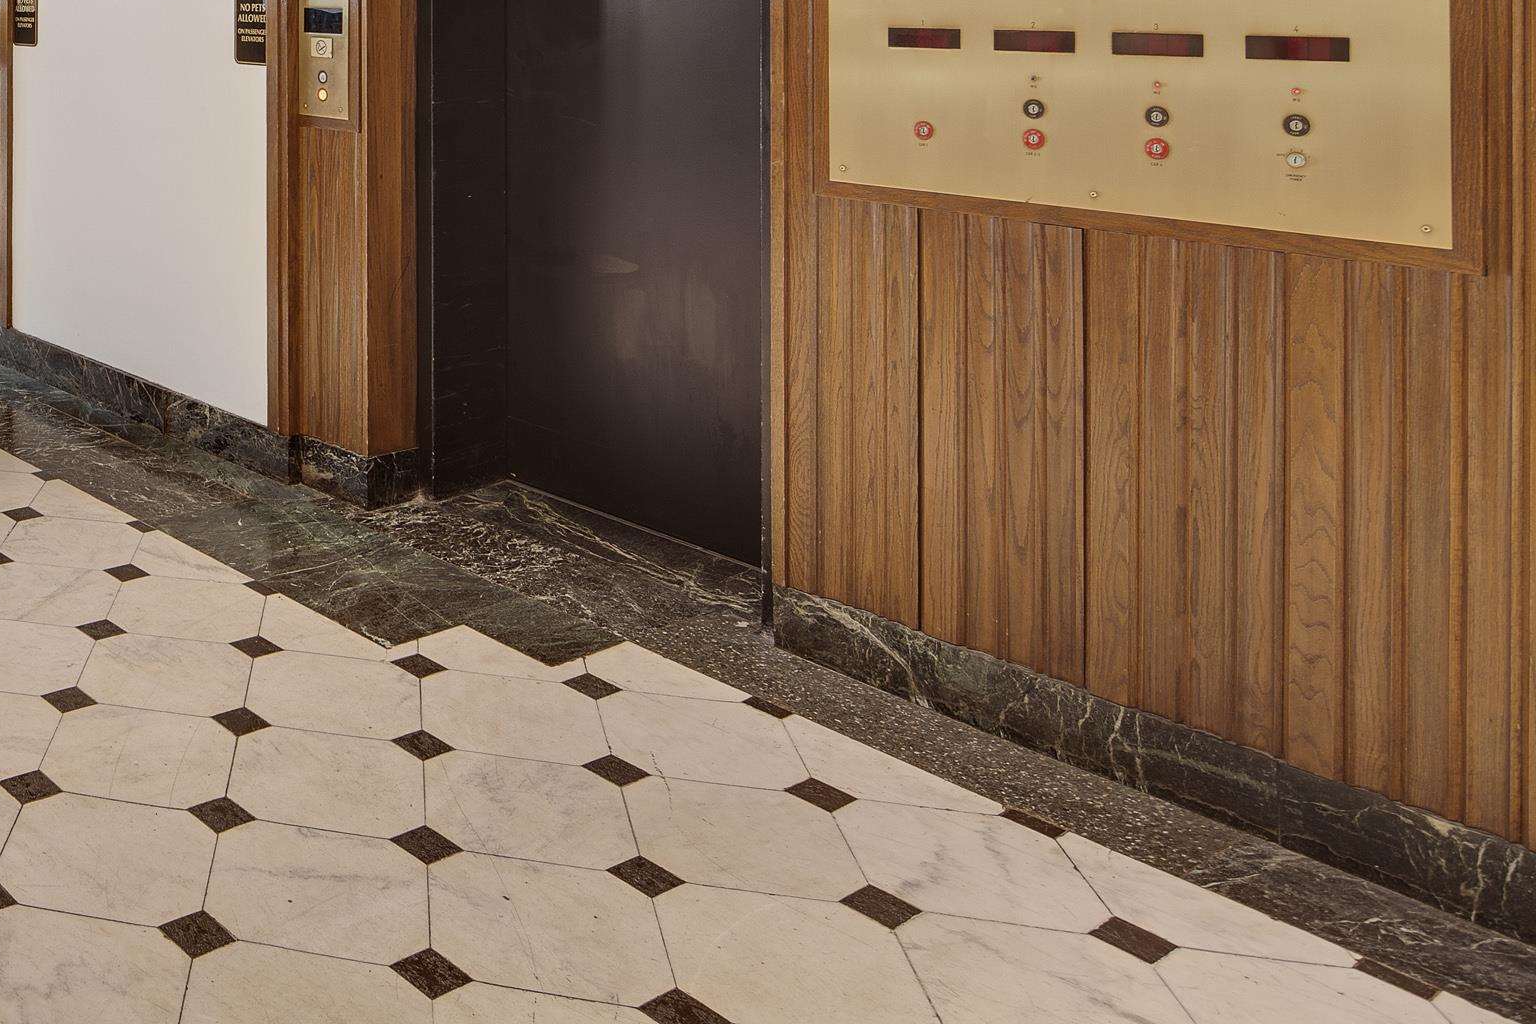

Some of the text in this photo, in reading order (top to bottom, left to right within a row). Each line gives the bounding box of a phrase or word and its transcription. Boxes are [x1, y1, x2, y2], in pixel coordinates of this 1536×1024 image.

[240, 3, 266, 12] NO PETS
[1153, 23, 1159, 31] 3
